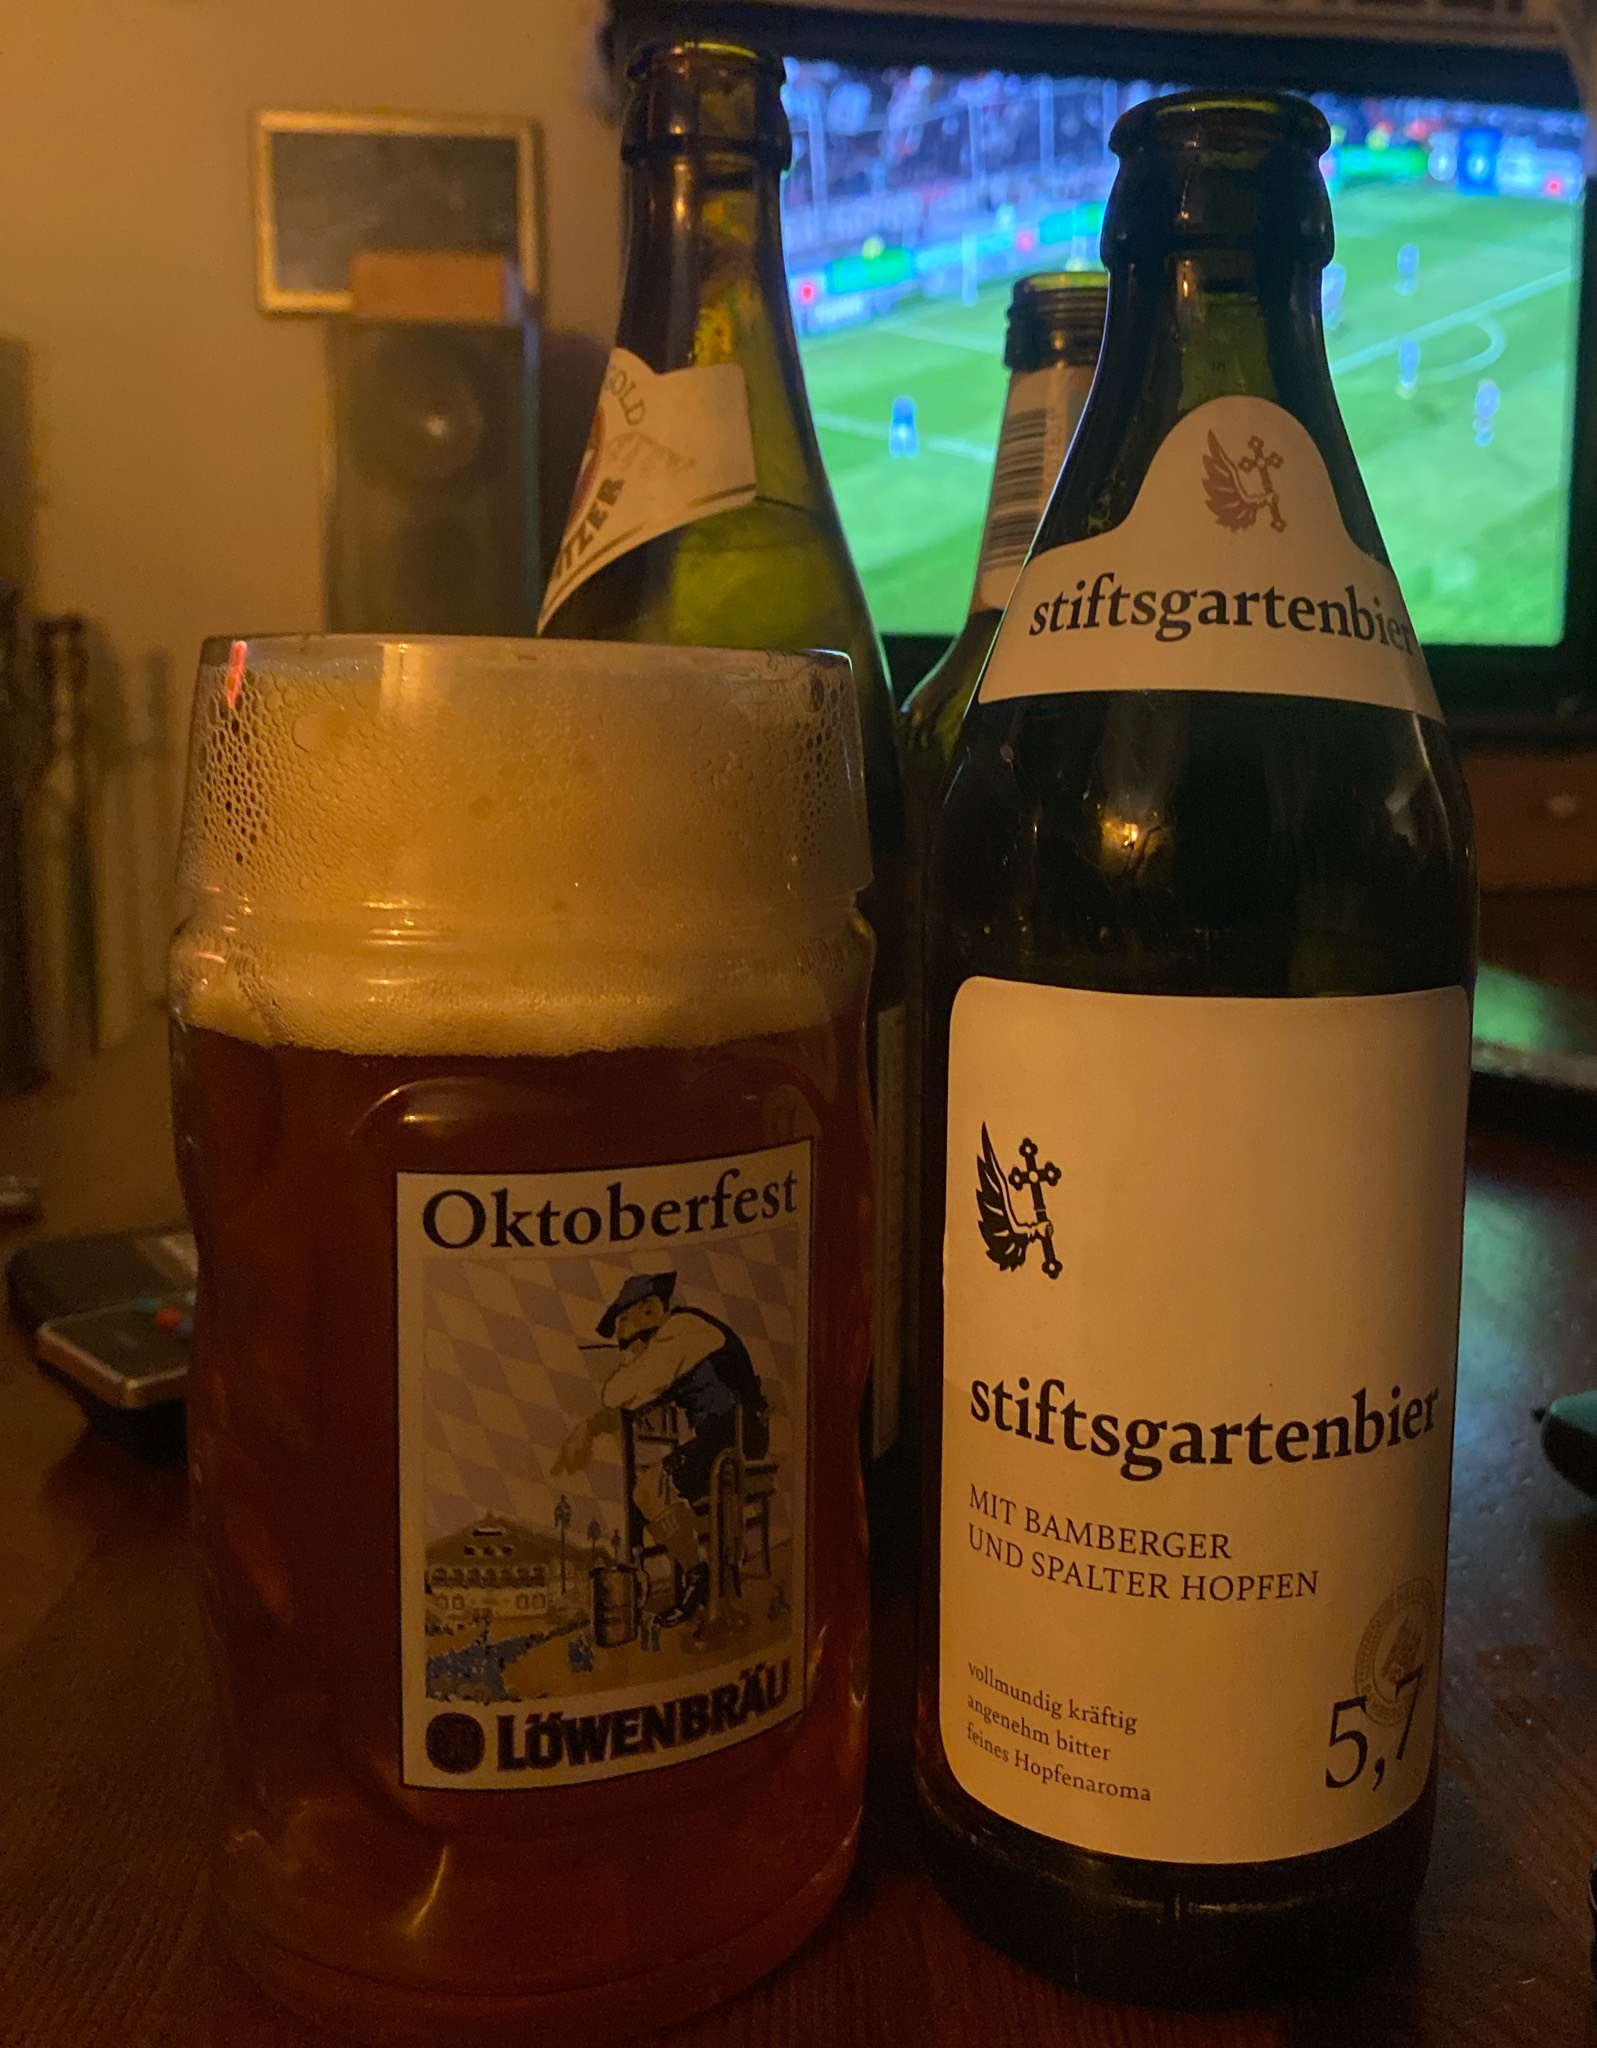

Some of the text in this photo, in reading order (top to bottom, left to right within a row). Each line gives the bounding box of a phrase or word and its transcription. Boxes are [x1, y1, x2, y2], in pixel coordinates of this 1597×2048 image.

[1029, 572, 1415, 657] stiftsgartenbier
[423, 1167, 798, 1249] Oktoberfest
[970, 1377, 1441, 1481] stiftsgartenbier
[969, 1484, 1232, 1560] MIT BAMBERGER
[969, 1523, 1320, 1602] UND SPALTER HOPFEN
[497, 1656, 792, 1772] LÖWENBRÄU
[967, 1660, 1138, 1735] vollmundig kräftig
[967, 1694, 1111, 1760] angenehm bitter
[1325, 1665, 1424, 1791] 5,7
[967, 1721, 1152, 1801] feines Hopfenaroma
